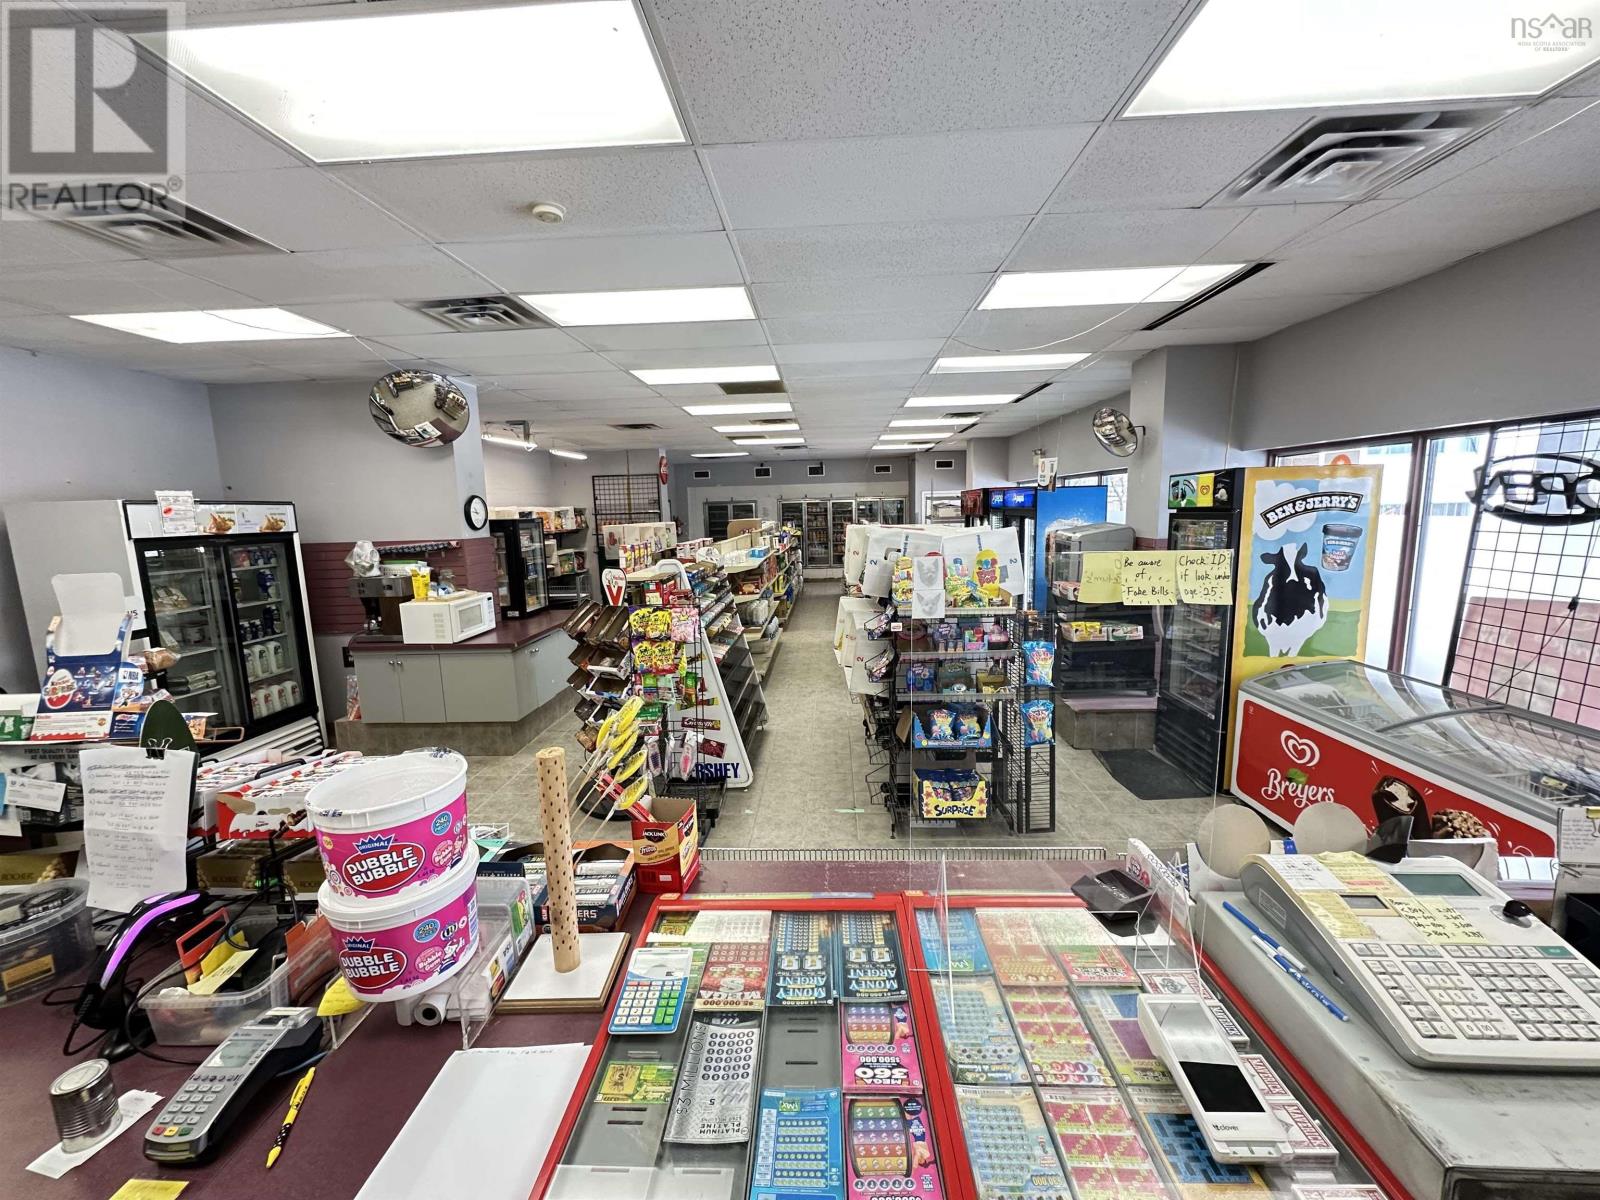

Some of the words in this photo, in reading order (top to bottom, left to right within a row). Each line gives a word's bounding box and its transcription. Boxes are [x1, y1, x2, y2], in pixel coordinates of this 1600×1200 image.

[1210, 554, 1226, 565] ID
[1180, 569, 1189, 582] if
[1196, 570, 1211, 580] look
[1151, 587, 1169, 596] Bills
[1203, 587, 1218, 596] 25
[695, 763, 740, 779] RSHEY
[1261, 768, 1335, 807] Breyers
[346, 847, 414, 875] DUBBLE
[352, 856, 418, 886] BUBBLE
[341, 952, 394, 967] DUBBLE
[346, 962, 400, 978] BUBBLE
[848, 969, 896, 978] ARGENT
[776, 977, 827, 986] ARGENT
[849, 980, 898, 990] MONEY
[776, 987, 826, 999] MONEY
[1210, 1005, 1243, 1037] MAVERICK
[681, 1023, 707, 1092] MILLIONS
[854, 1067, 909, 1079] 360
[1250, 1058, 1288, 1095] MAVERICK
[676, 1097, 691, 1115] $3
[1219, 1124, 1239, 1132] clover
[1285, 1104, 1330, 1148] MAVERICK
